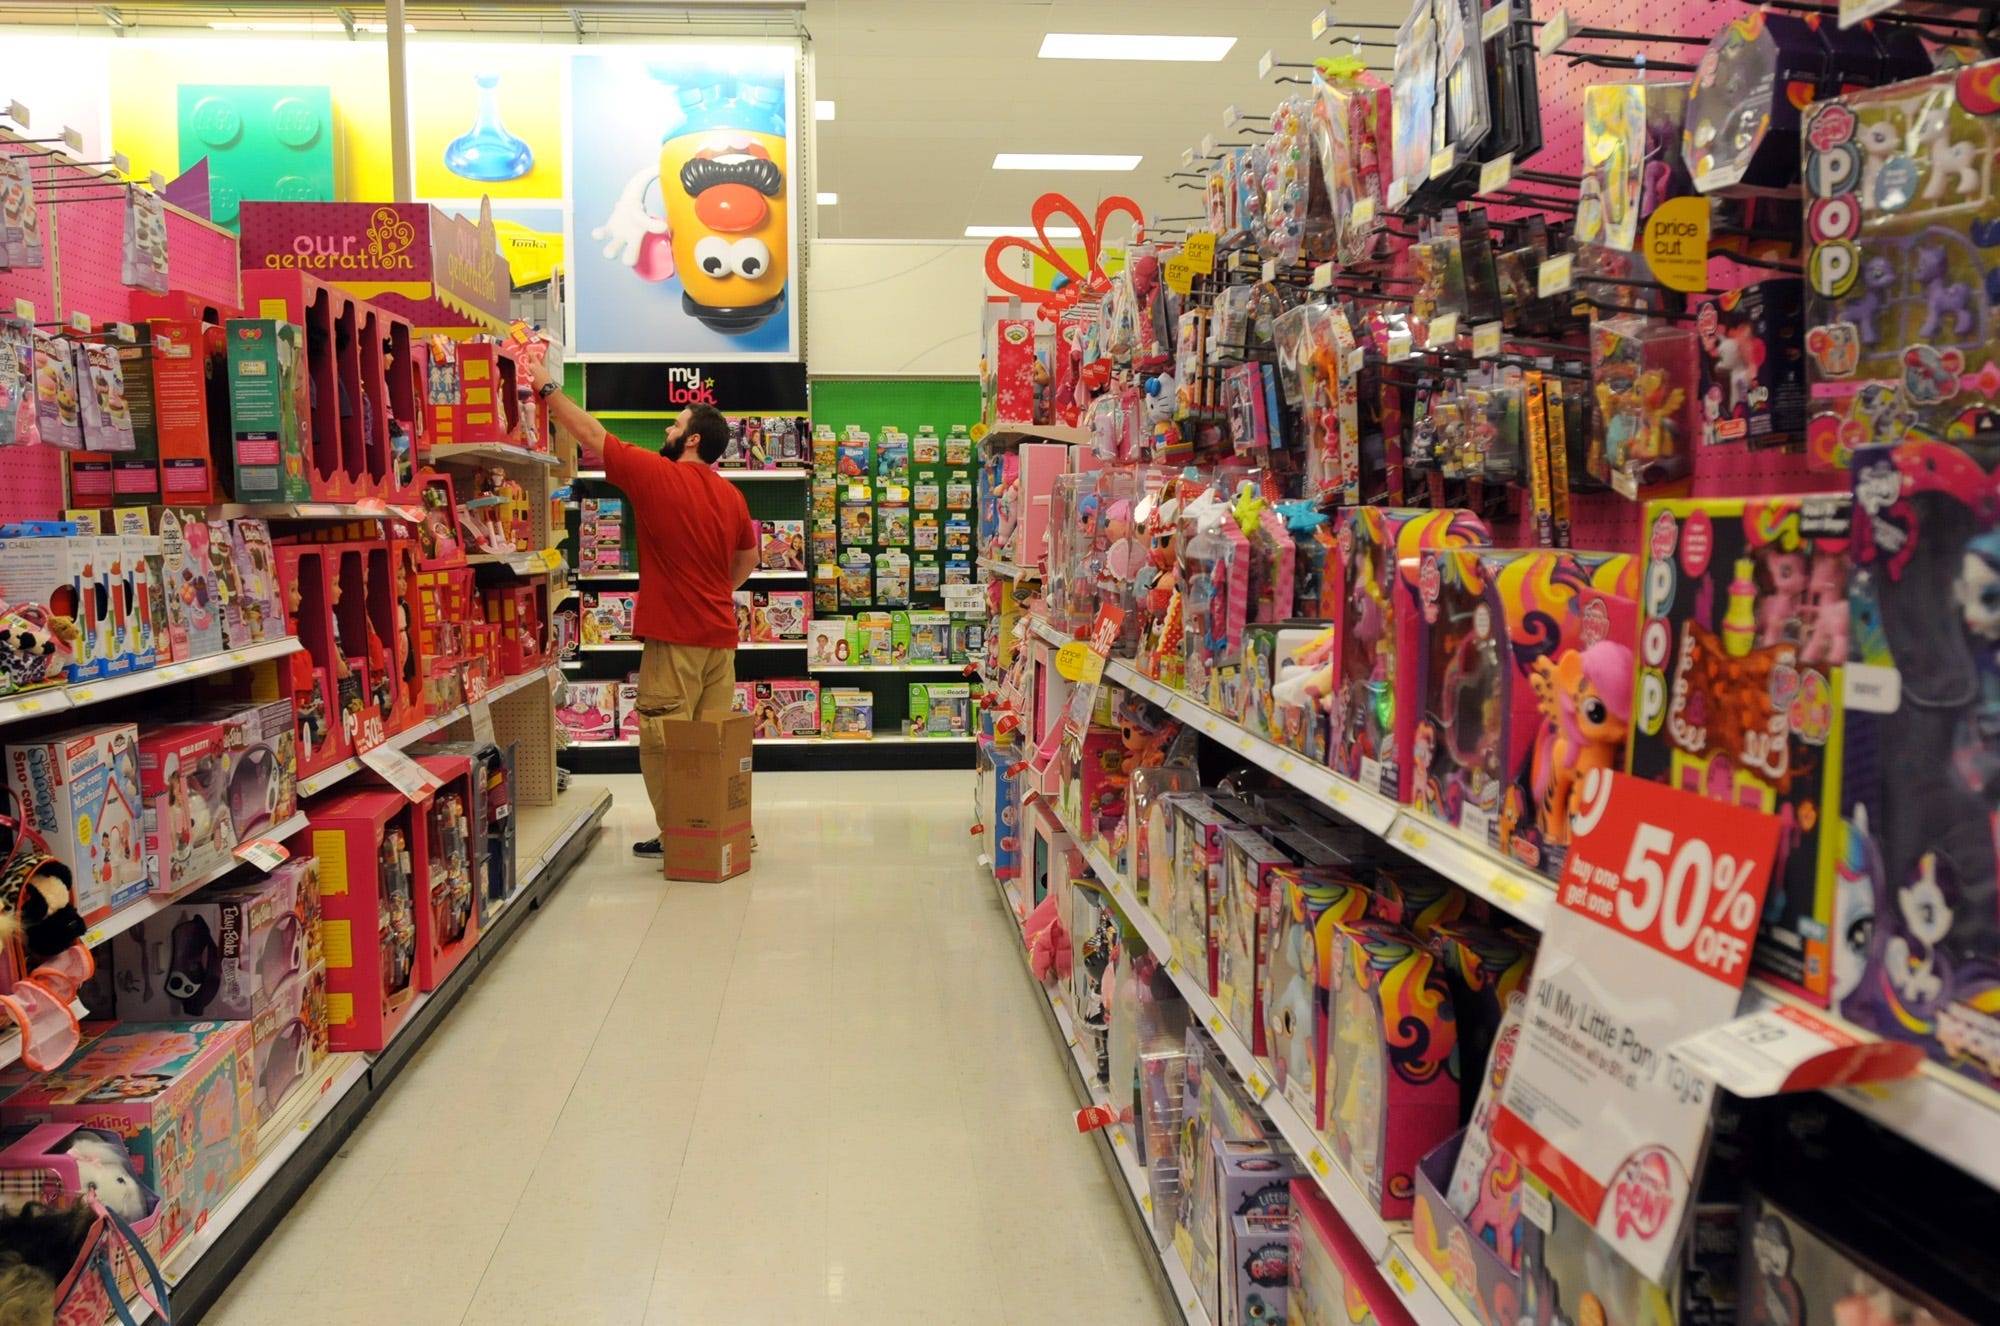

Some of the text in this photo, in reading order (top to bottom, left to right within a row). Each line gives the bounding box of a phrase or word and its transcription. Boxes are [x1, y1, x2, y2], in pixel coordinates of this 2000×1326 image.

[1655, 218, 1698, 239] price
[293, 235, 357, 256] our
[508, 237, 548, 249] Tonka
[1188, 242, 1210, 250] price
[1654, 240, 1682, 255] cut
[265, 247, 414, 270] generation
[1169, 264, 1189, 272] price
[1168, 271, 1181, 279] cut
[668, 367, 700, 389] my
[668, 381, 718, 405] look
[1062, 650, 1081, 658] price
[13, 751, 36, 827] Sno-cone
[27, 747, 58, 833] Snoopy
[1570, 854, 1620, 892] buy one
[1616, 821, 1756, 952] 50%
[1566, 884, 1615, 919] get one
[1694, 927, 1748, 974] OFF
[1537, 979, 1555, 1009] All
[1555, 989, 1577, 1029] My
[1580, 1004, 1618, 1049] Little
[1620, 1027, 1662, 1081] Pony
[1665, 1053, 1705, 1104] Toys
